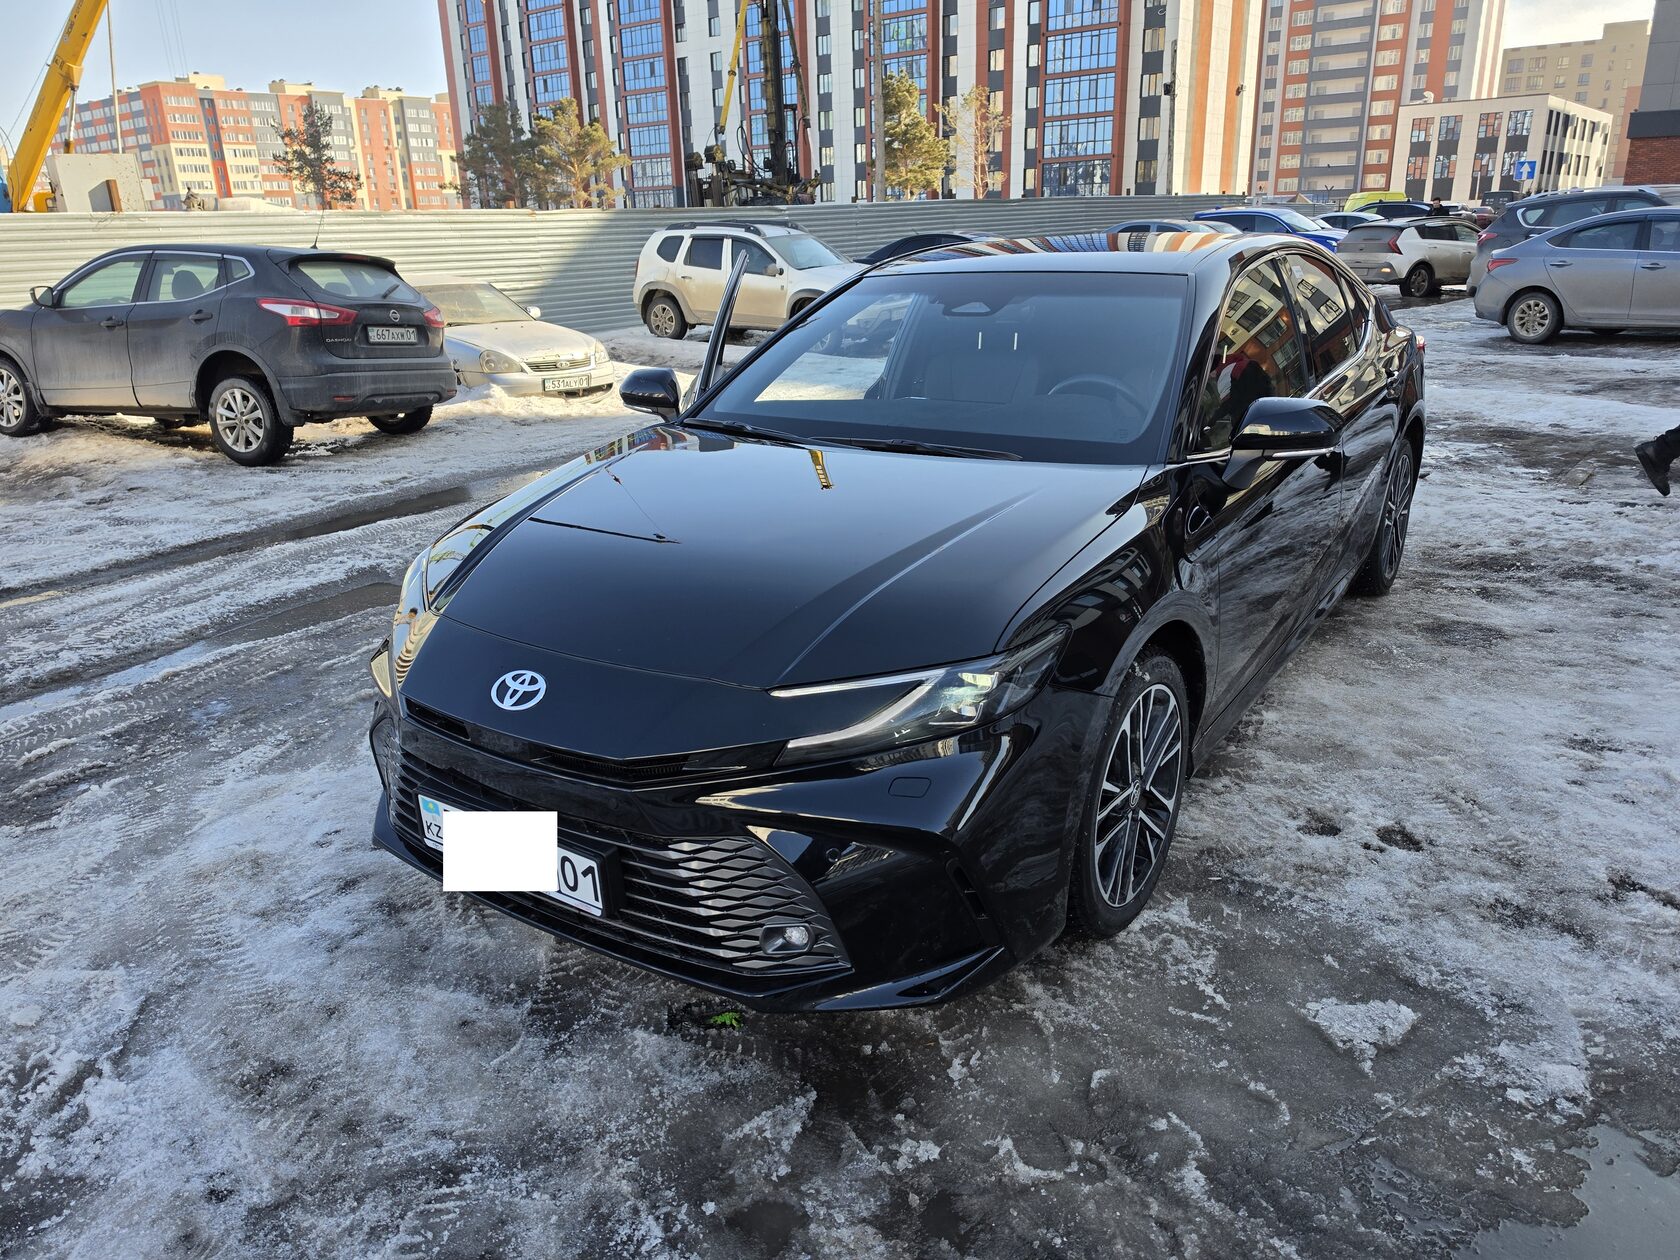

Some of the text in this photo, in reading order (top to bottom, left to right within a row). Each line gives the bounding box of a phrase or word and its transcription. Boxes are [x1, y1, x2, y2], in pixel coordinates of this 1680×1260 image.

[406, 329, 416, 341] 01
[425, 820, 443, 839] KZ
[560, 855, 600, 903] 01
